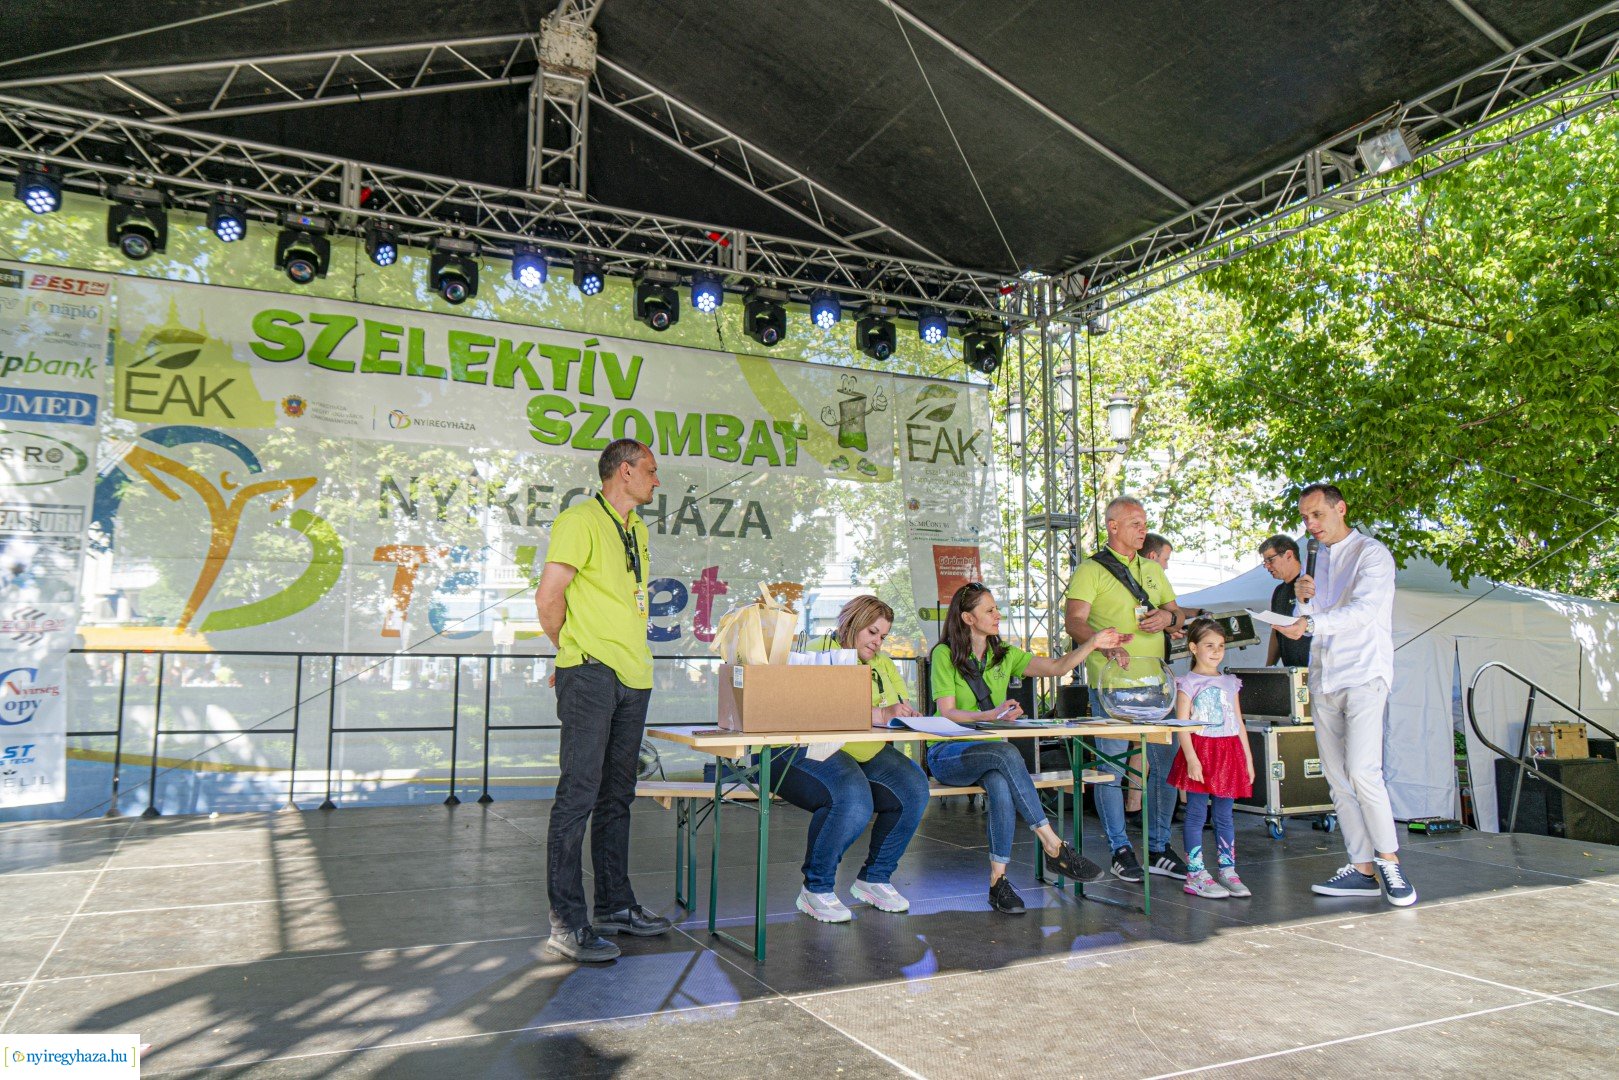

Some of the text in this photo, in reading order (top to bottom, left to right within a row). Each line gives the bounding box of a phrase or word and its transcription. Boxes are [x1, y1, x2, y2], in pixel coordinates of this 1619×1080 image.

[30, 274, 88, 292] BEST
[248, 308, 644, 400] SZELEKTÍV
[124, 370, 236, 420] EAK
[413, 417, 476, 431] NYÍREGYHÁZA
[525, 394, 808, 467] SZOMBAT
[906, 423, 988, 467] EAK
[378, 468, 773, 540] NYÍREHÁZA
